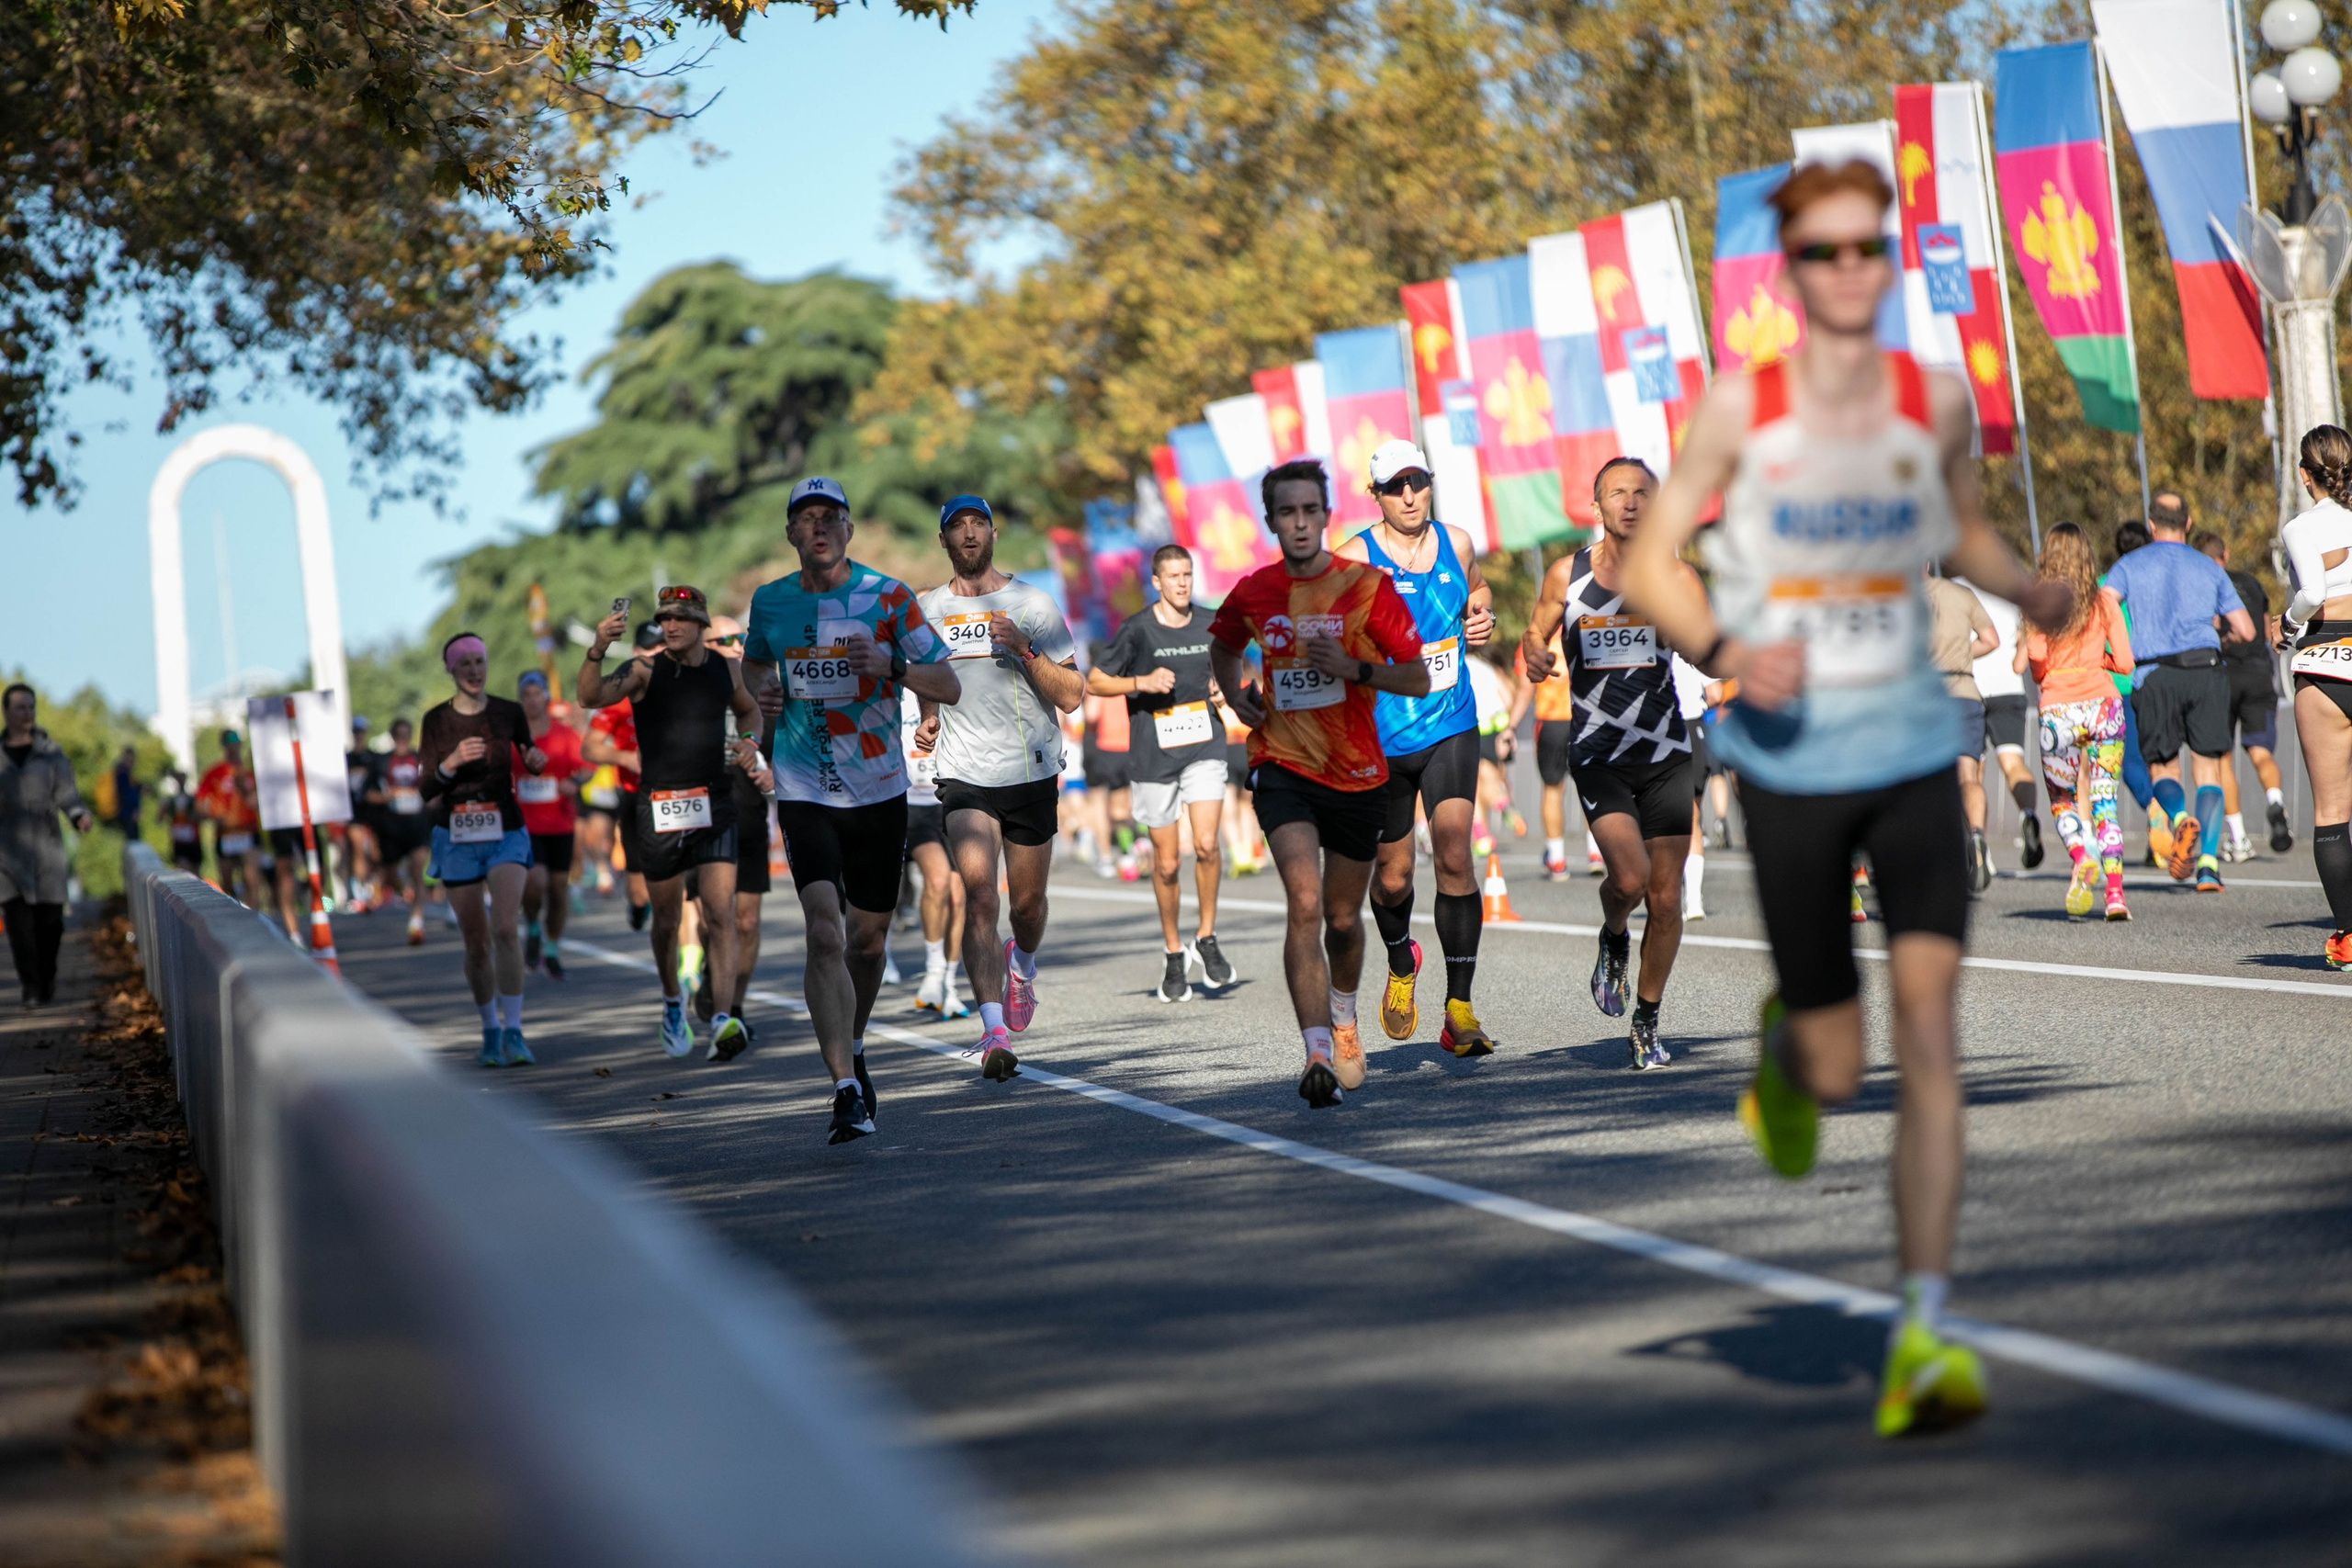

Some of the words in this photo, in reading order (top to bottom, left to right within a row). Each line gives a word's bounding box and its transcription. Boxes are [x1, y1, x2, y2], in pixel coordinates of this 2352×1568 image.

[949, 623, 990, 642] 340
[1589, 628, 1649, 649] 3964
[2303, 647, 2352, 661] 4713
[792, 660, 851, 679] 4668
[816, 722, 834, 755] FOR
[661, 798, 703, 816] 6576
[454, 813, 496, 828] 6599
